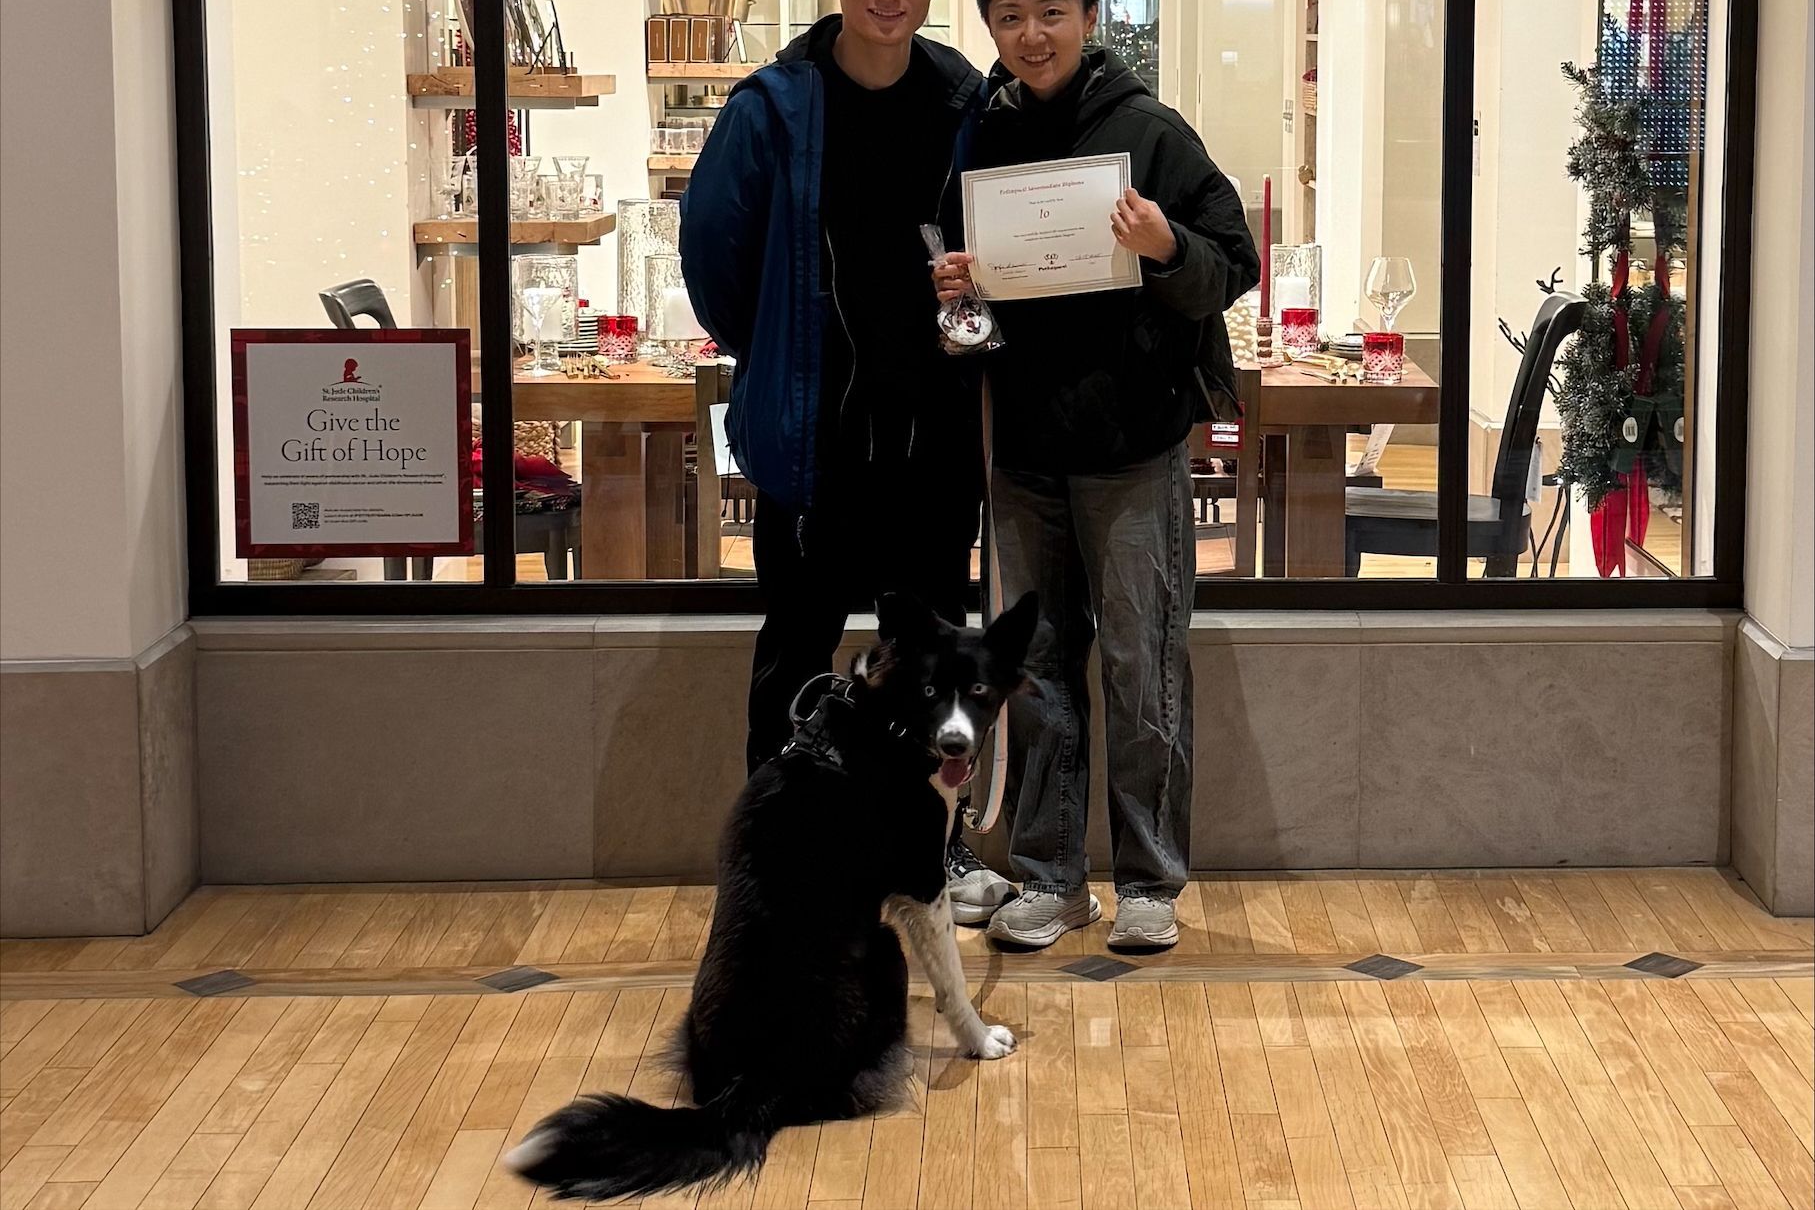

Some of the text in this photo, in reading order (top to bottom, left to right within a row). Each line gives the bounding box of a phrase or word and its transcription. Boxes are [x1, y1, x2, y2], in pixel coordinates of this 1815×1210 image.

[353, 395, 381, 403] Hospital
[307, 407, 401, 432] Give the
[281, 437, 427, 470] Gift of Hope
